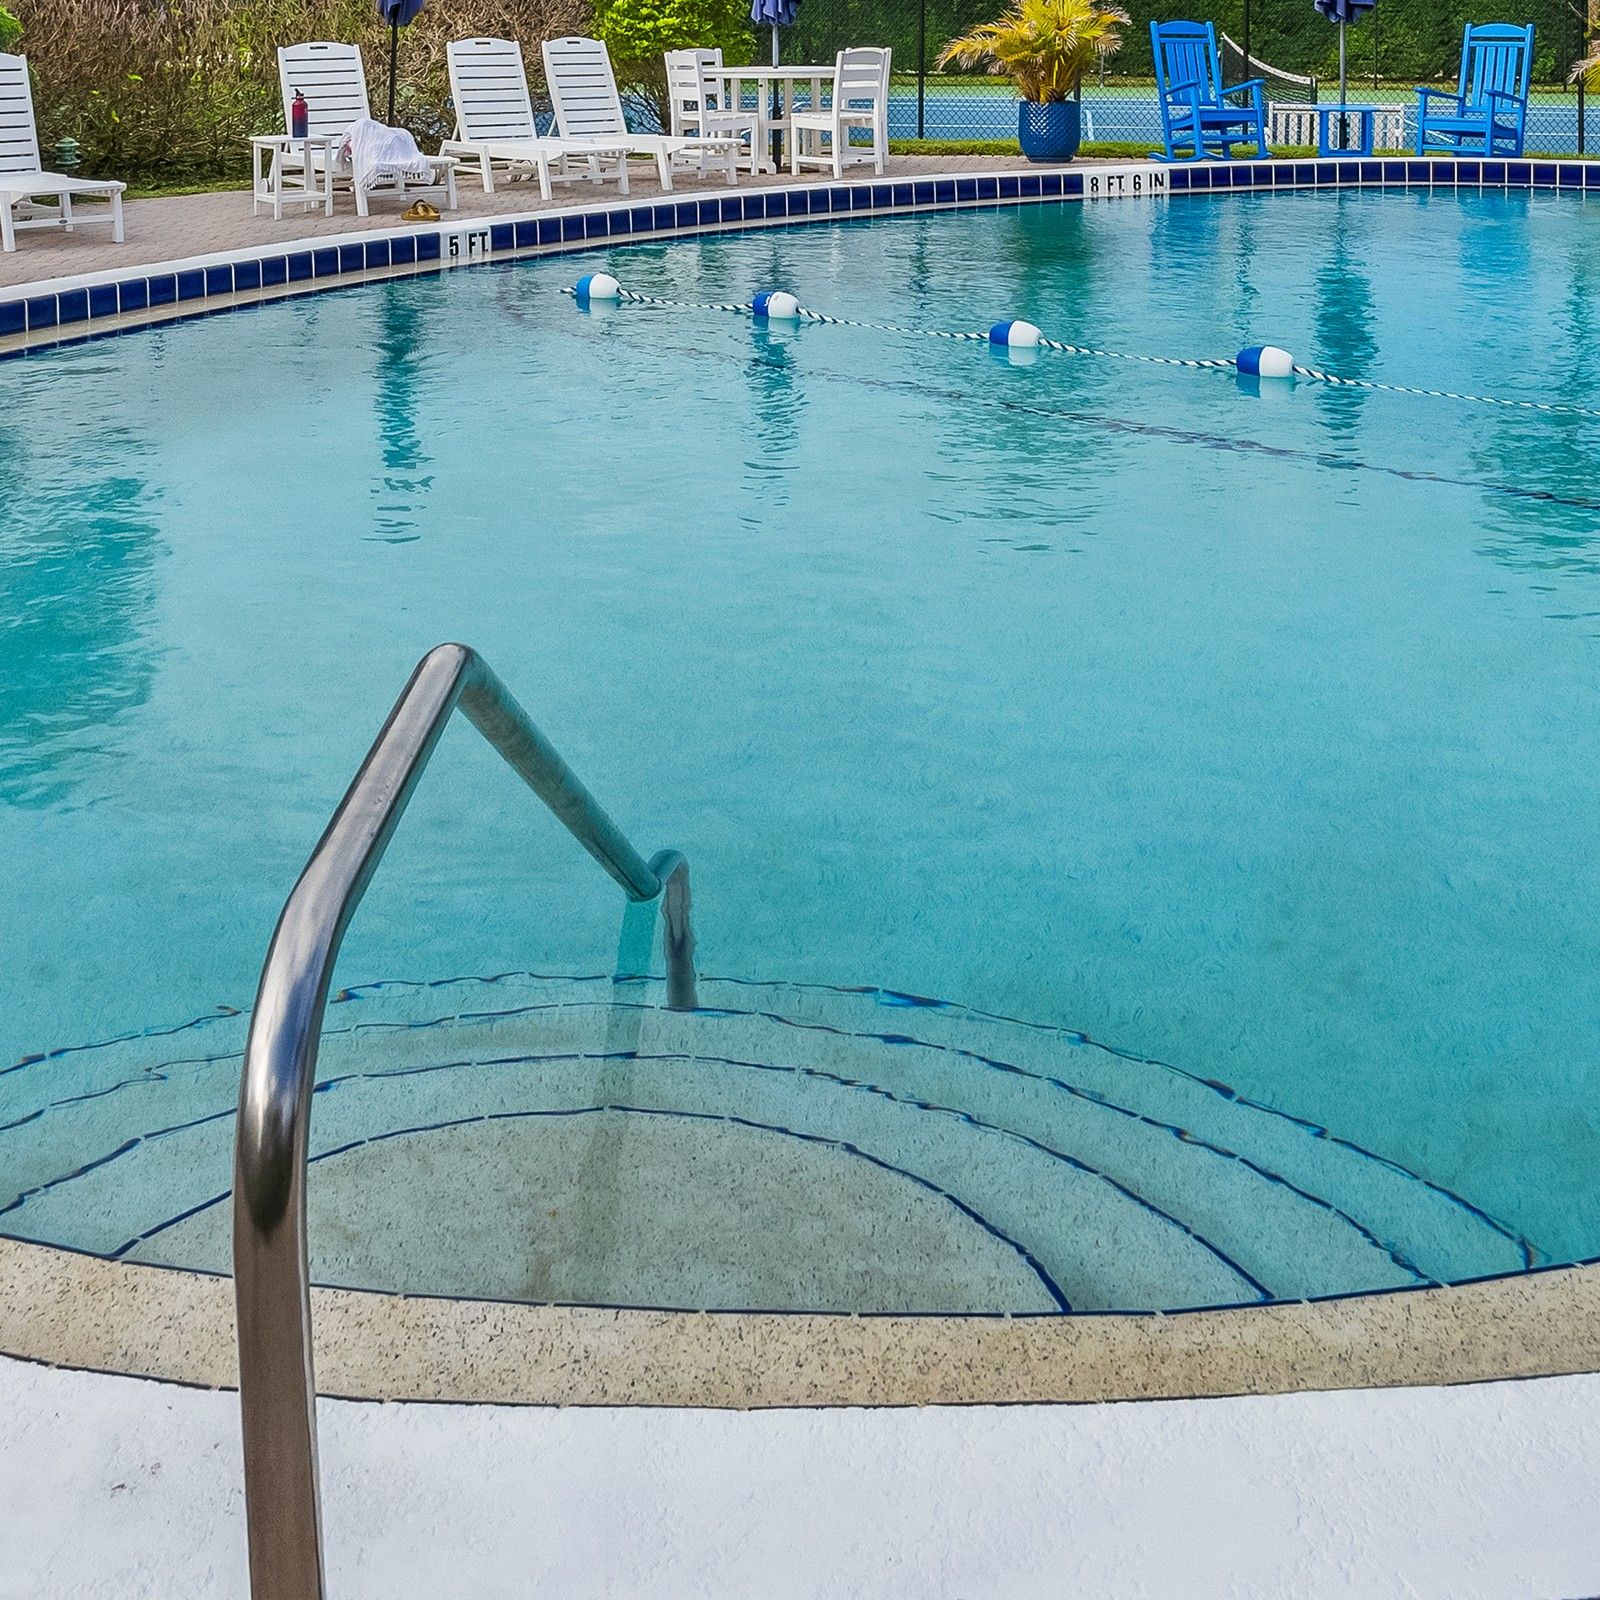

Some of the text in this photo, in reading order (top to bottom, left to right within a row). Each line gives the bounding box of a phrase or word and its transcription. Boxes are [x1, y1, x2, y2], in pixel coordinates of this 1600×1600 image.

[1090, 176, 1099, 193] 8
[1133, 174, 1142, 191] 6
[449, 231, 489, 257] 5 FT.
